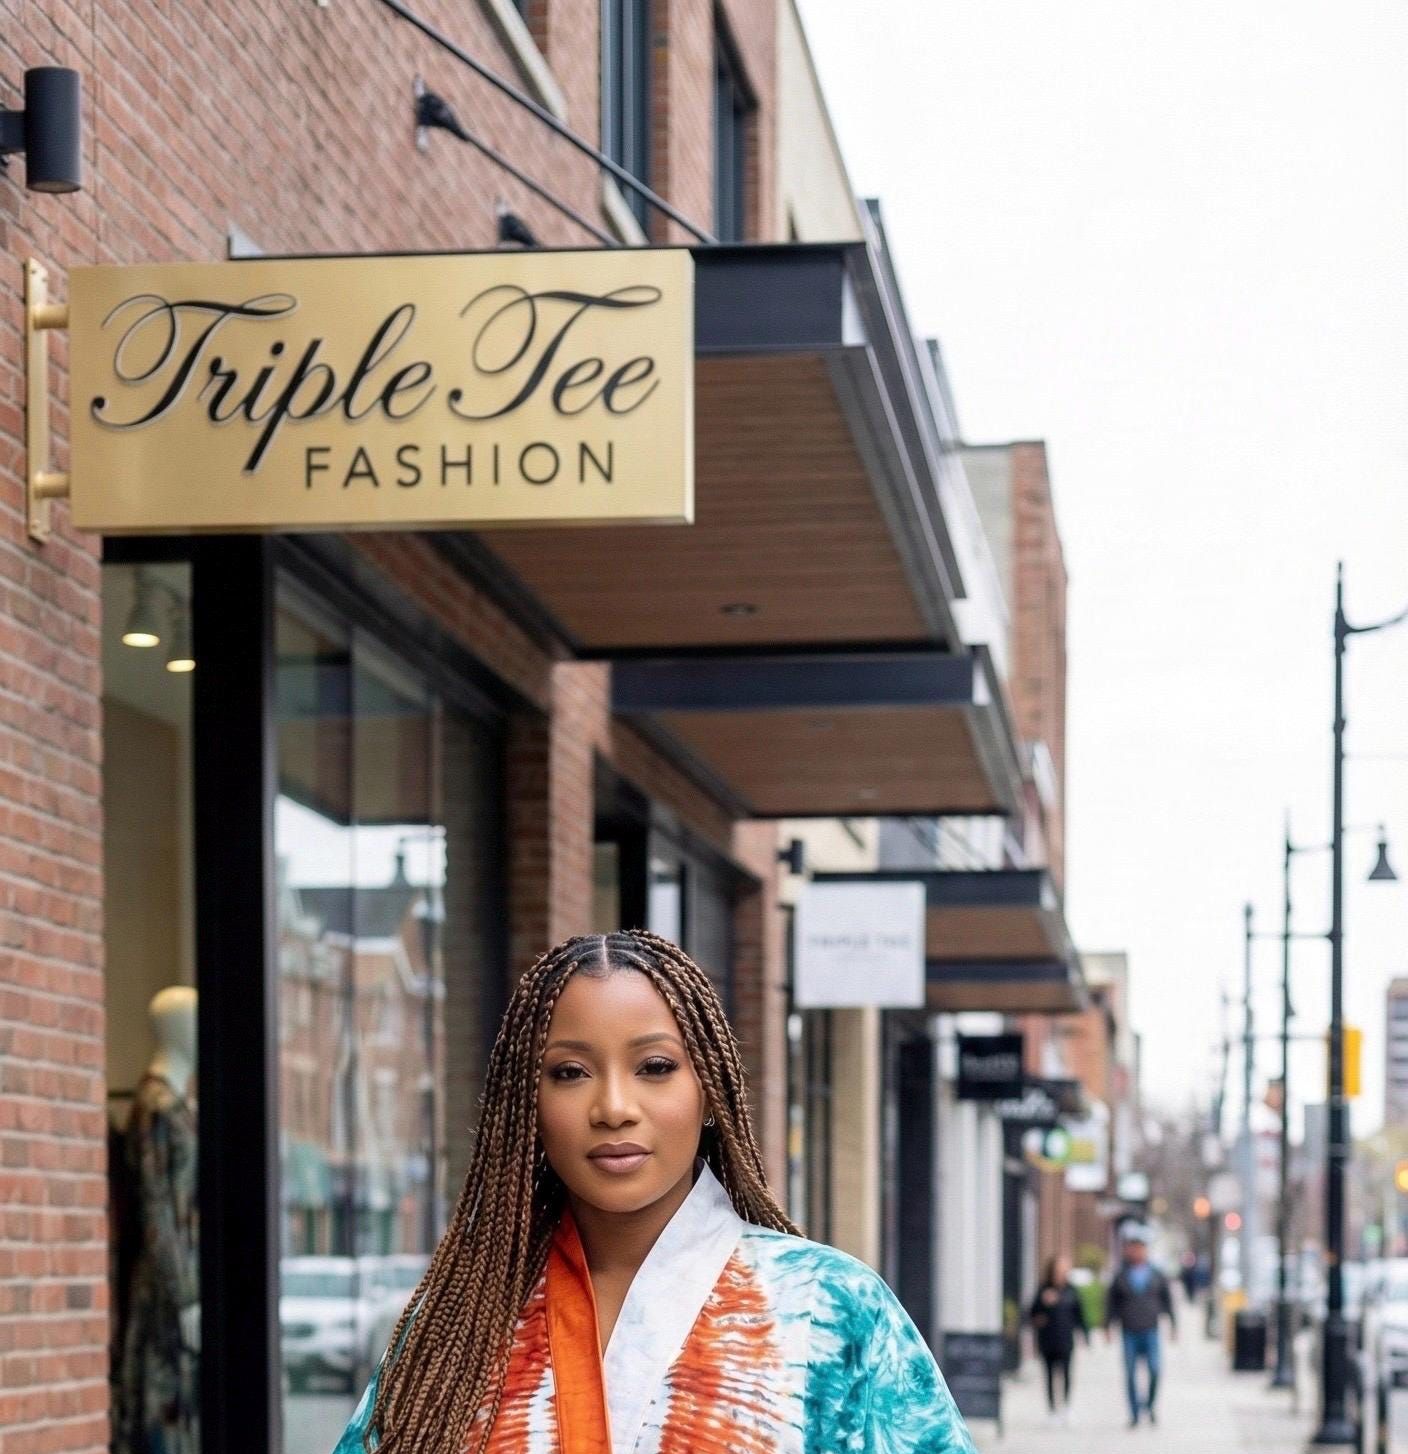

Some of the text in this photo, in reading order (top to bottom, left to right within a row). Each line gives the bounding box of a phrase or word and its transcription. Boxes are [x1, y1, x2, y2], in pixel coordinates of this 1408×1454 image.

[91, 284, 662, 471] Triple Tee
[306, 442, 614, 488] FASHION
